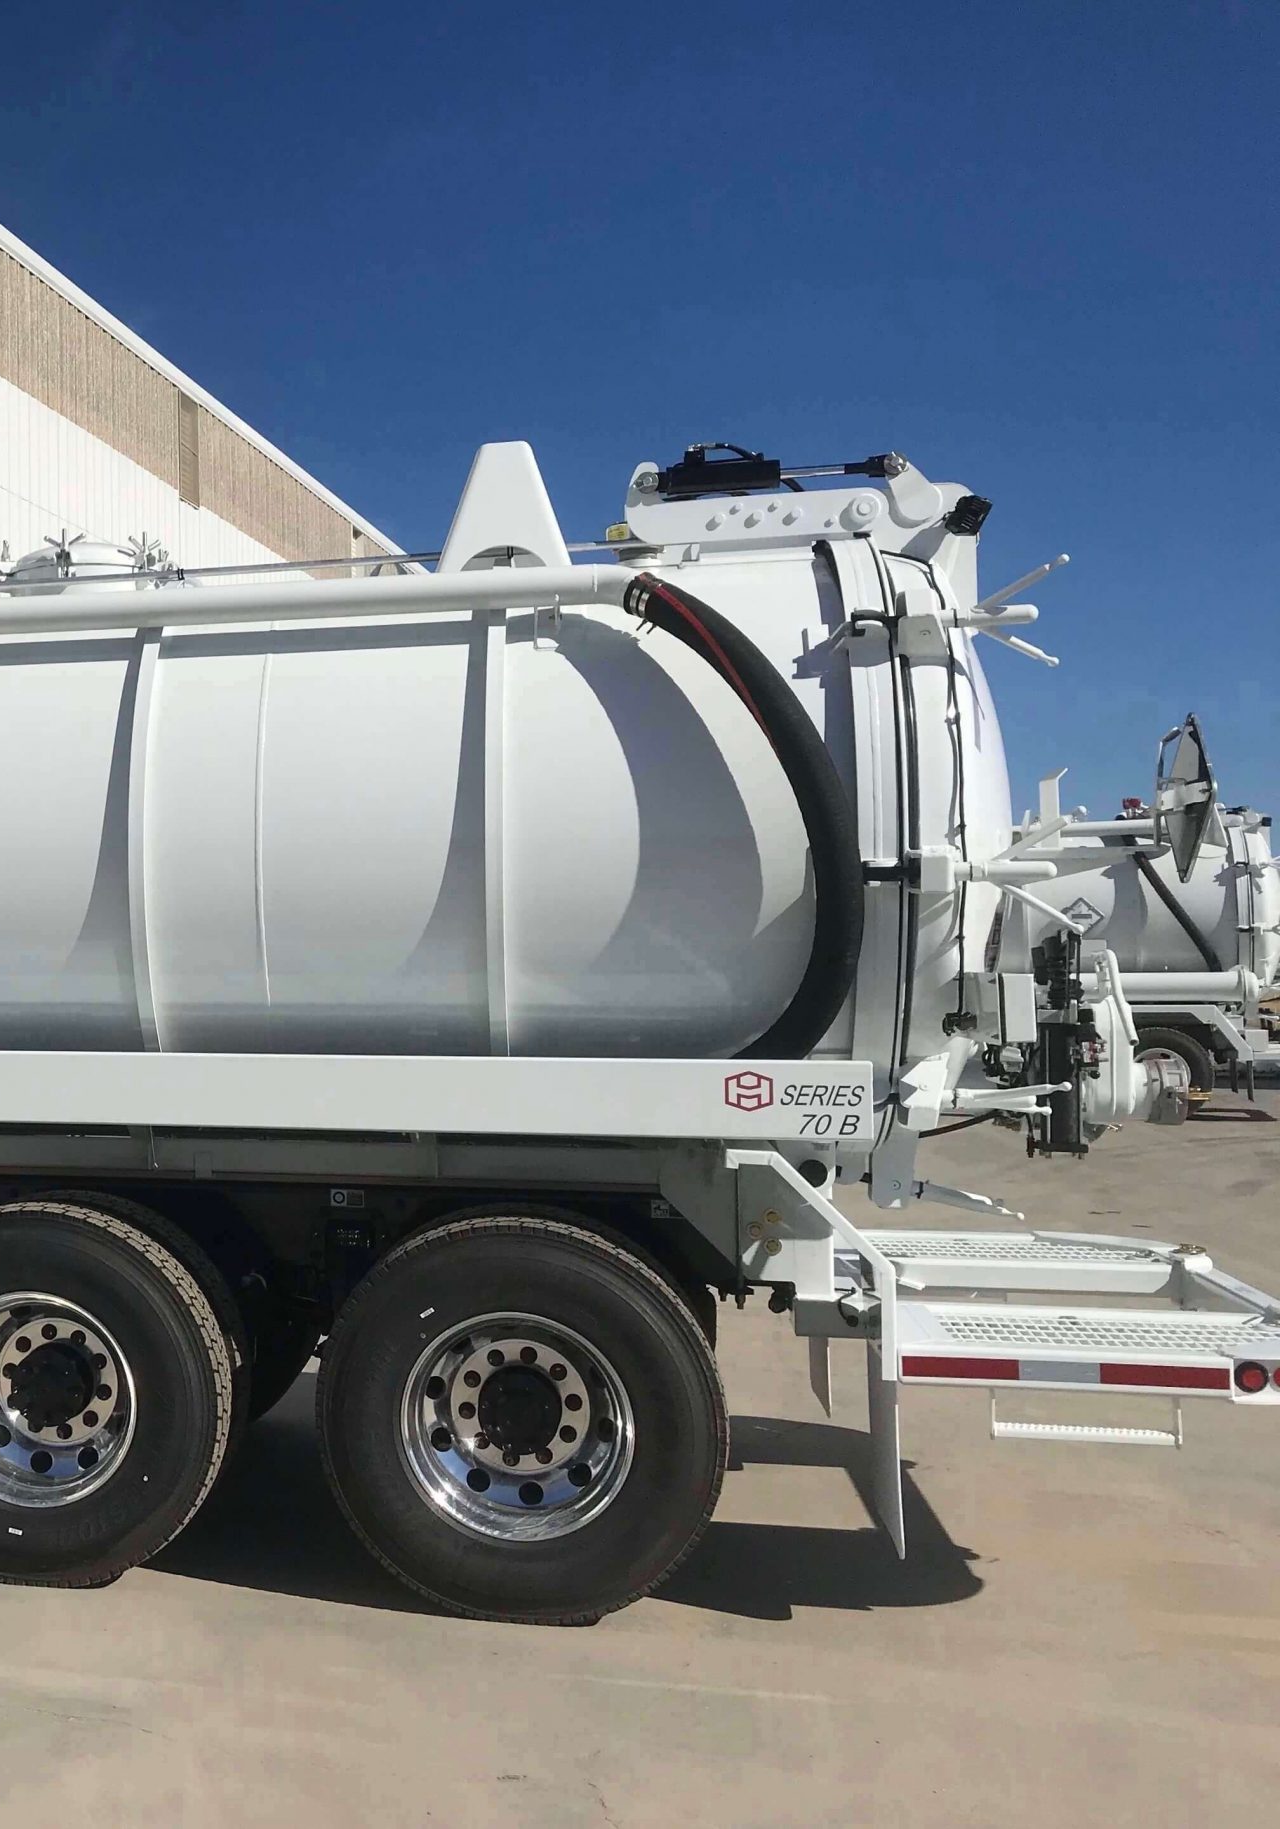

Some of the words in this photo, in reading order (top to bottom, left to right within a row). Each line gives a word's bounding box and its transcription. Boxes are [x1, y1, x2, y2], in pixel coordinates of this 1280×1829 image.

[780, 1084, 865, 1107] SERIES
[799, 1114, 832, 1136] 70
[838, 1114, 861, 1136] B
